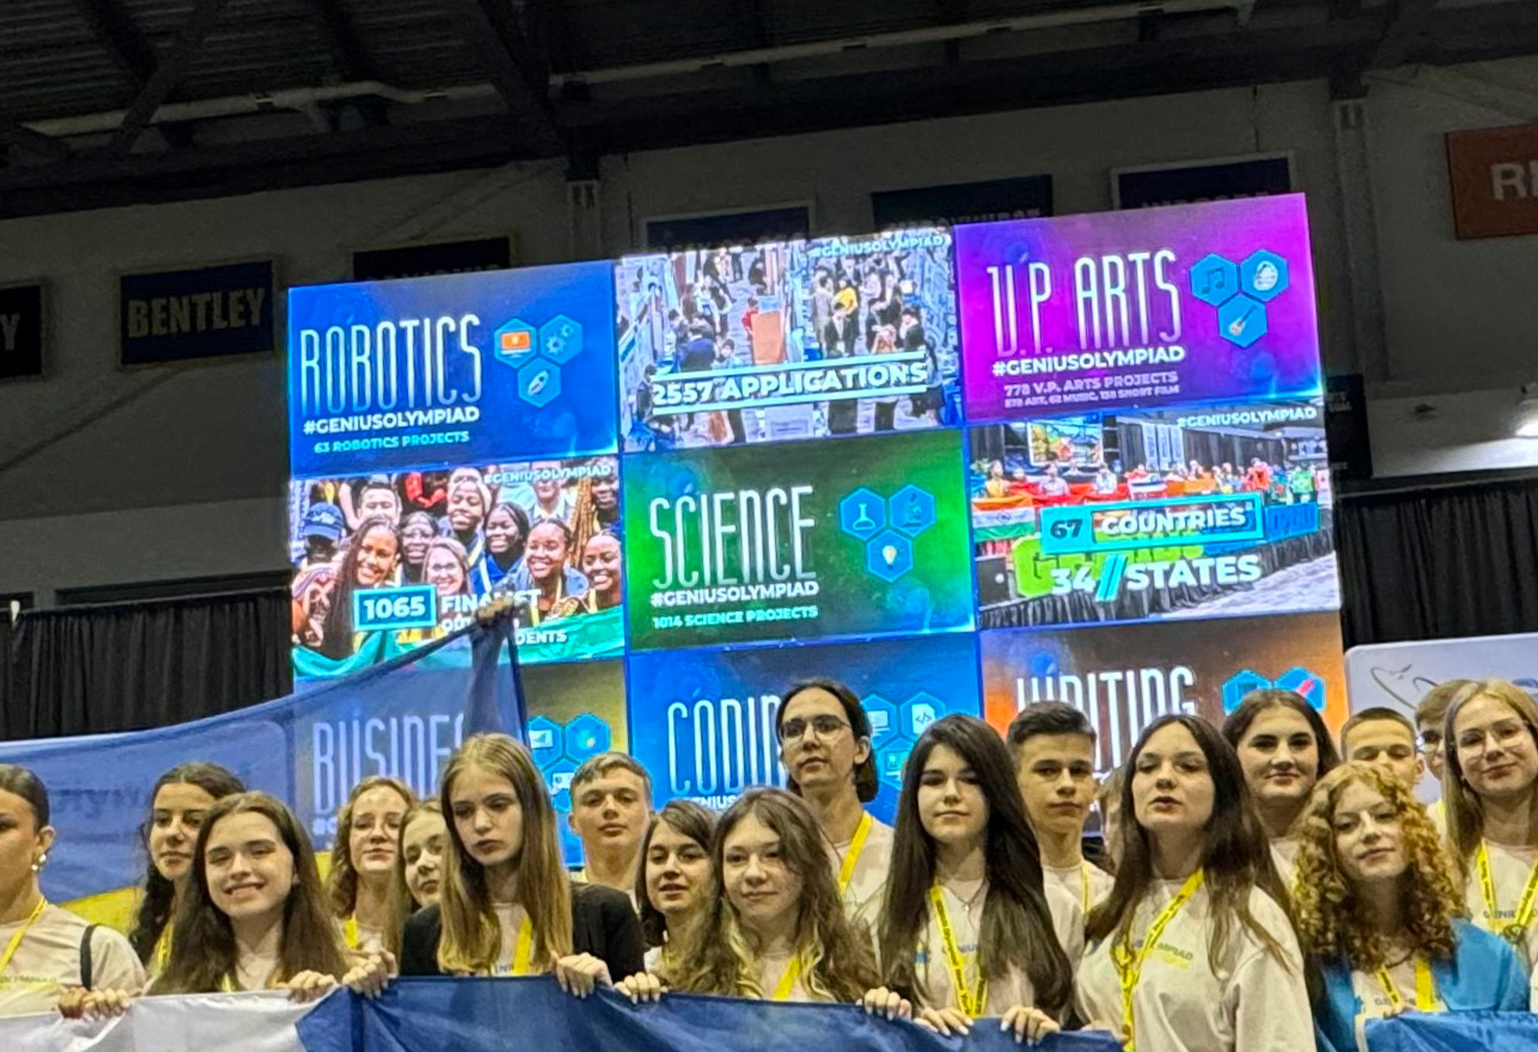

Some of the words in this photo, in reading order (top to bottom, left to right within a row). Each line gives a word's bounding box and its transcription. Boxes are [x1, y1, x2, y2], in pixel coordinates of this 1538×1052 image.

[128, 288, 262, 338] BENTLEY
[1075, 250, 1183, 350] ARTS
[300, 313, 482, 416] ROBOTICS
[992, 346, 1186, 376] #GENIUSOLYMPIAD
[652, 382, 713, 405] 2557
[721, 363, 928, 400] APPLICATIONS
[1033, 380, 1061, 395] V.P.
[1064, 377, 1101, 392] ARTS
[1104, 371, 1179, 387] PROJECTS
[303, 406, 480, 434] #GENIUSOLYMPIAD
[1177, 407, 1317, 427] #GENIUSOLYMPIAD
[333, 436, 400, 452] ROBOTICS
[402, 431, 470, 446] PROJECTS
[483, 464, 611, 484] #GENIUSOLYMPIAD
[650, 485, 817, 590] SCIENCE
[1050, 519, 1083, 539] 67
[1102, 508, 1247, 536] COUNTRIES
[1051, 567, 1097, 595] 34
[1126, 554, 1261, 591] STATES
[364, 595, 425, 619] 1065
[651, 580, 820, 607] #GENIUSOLYMPIAD
[685, 611, 745, 626] SCIENCE
[746, 605, 819, 622] PROJECTS
[667, 694, 787, 797] CODIN
